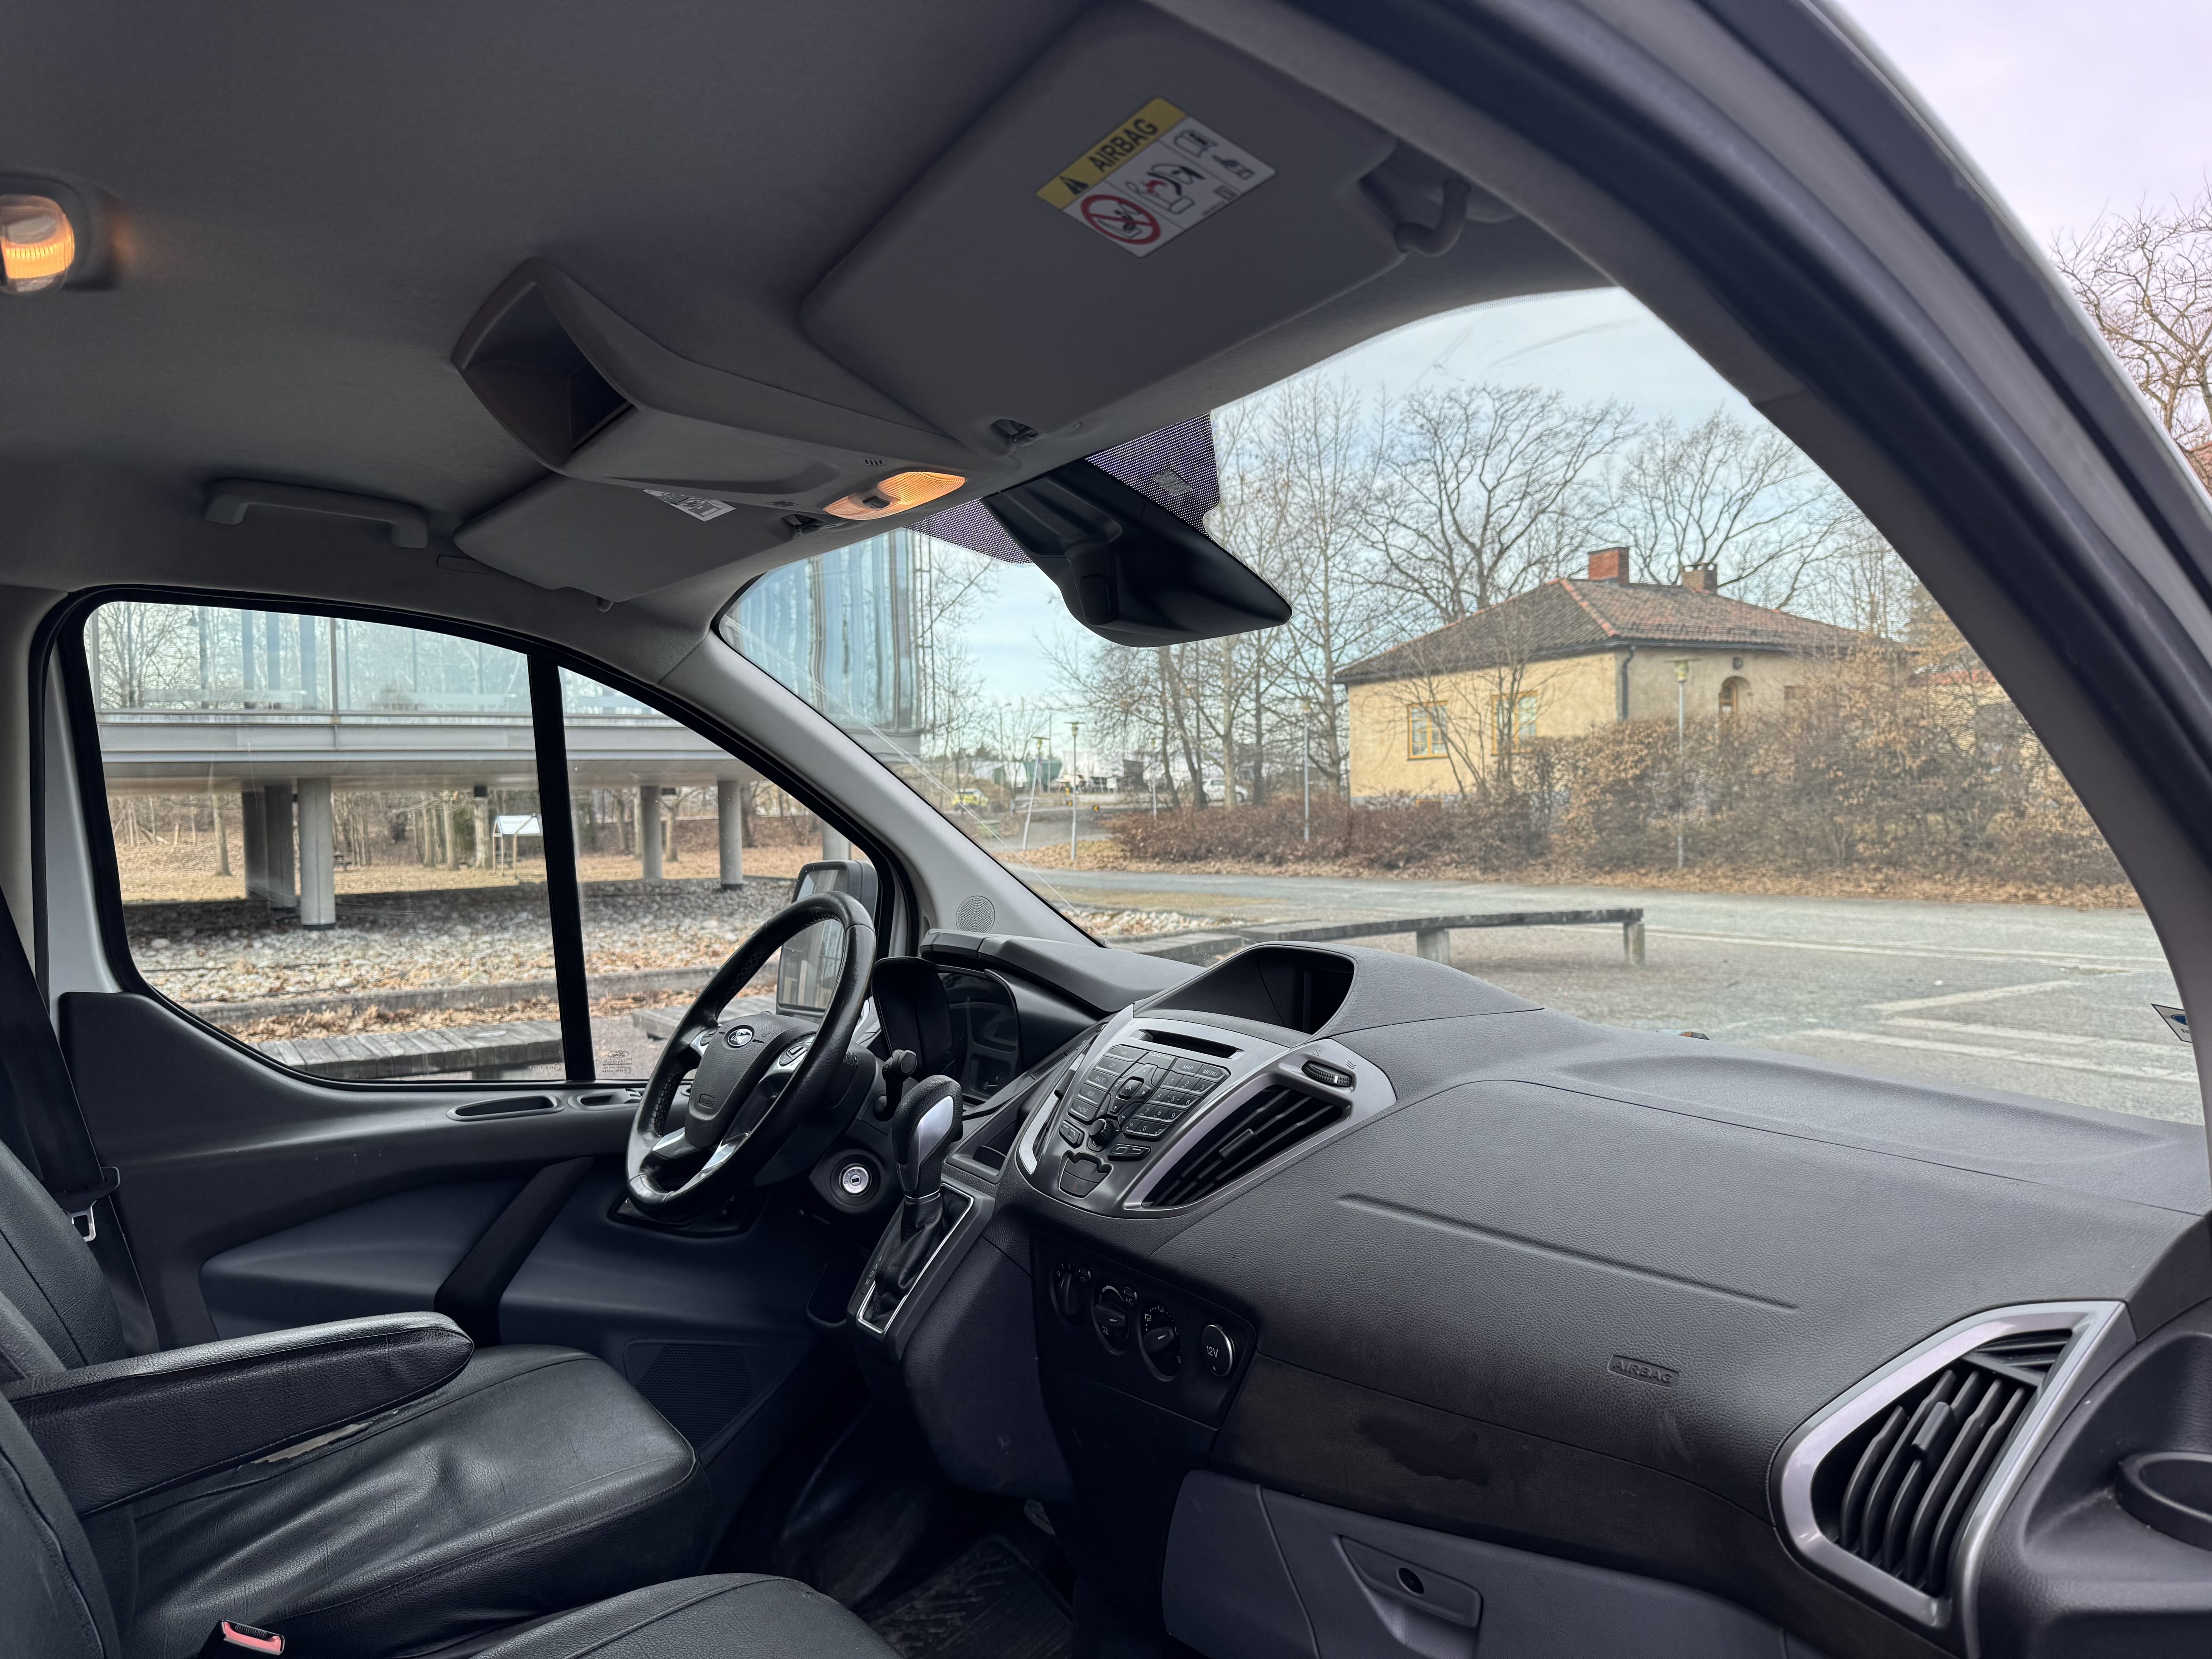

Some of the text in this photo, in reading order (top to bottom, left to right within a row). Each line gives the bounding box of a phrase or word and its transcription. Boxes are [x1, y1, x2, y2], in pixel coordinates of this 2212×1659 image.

[1088, 118, 1159, 173] AIRBAG
[1077, 1105, 1089, 1114] PHONE
[1206, 1345, 1219, 1358] 12V
[1612, 1359, 1673, 1382] AIRBAG
